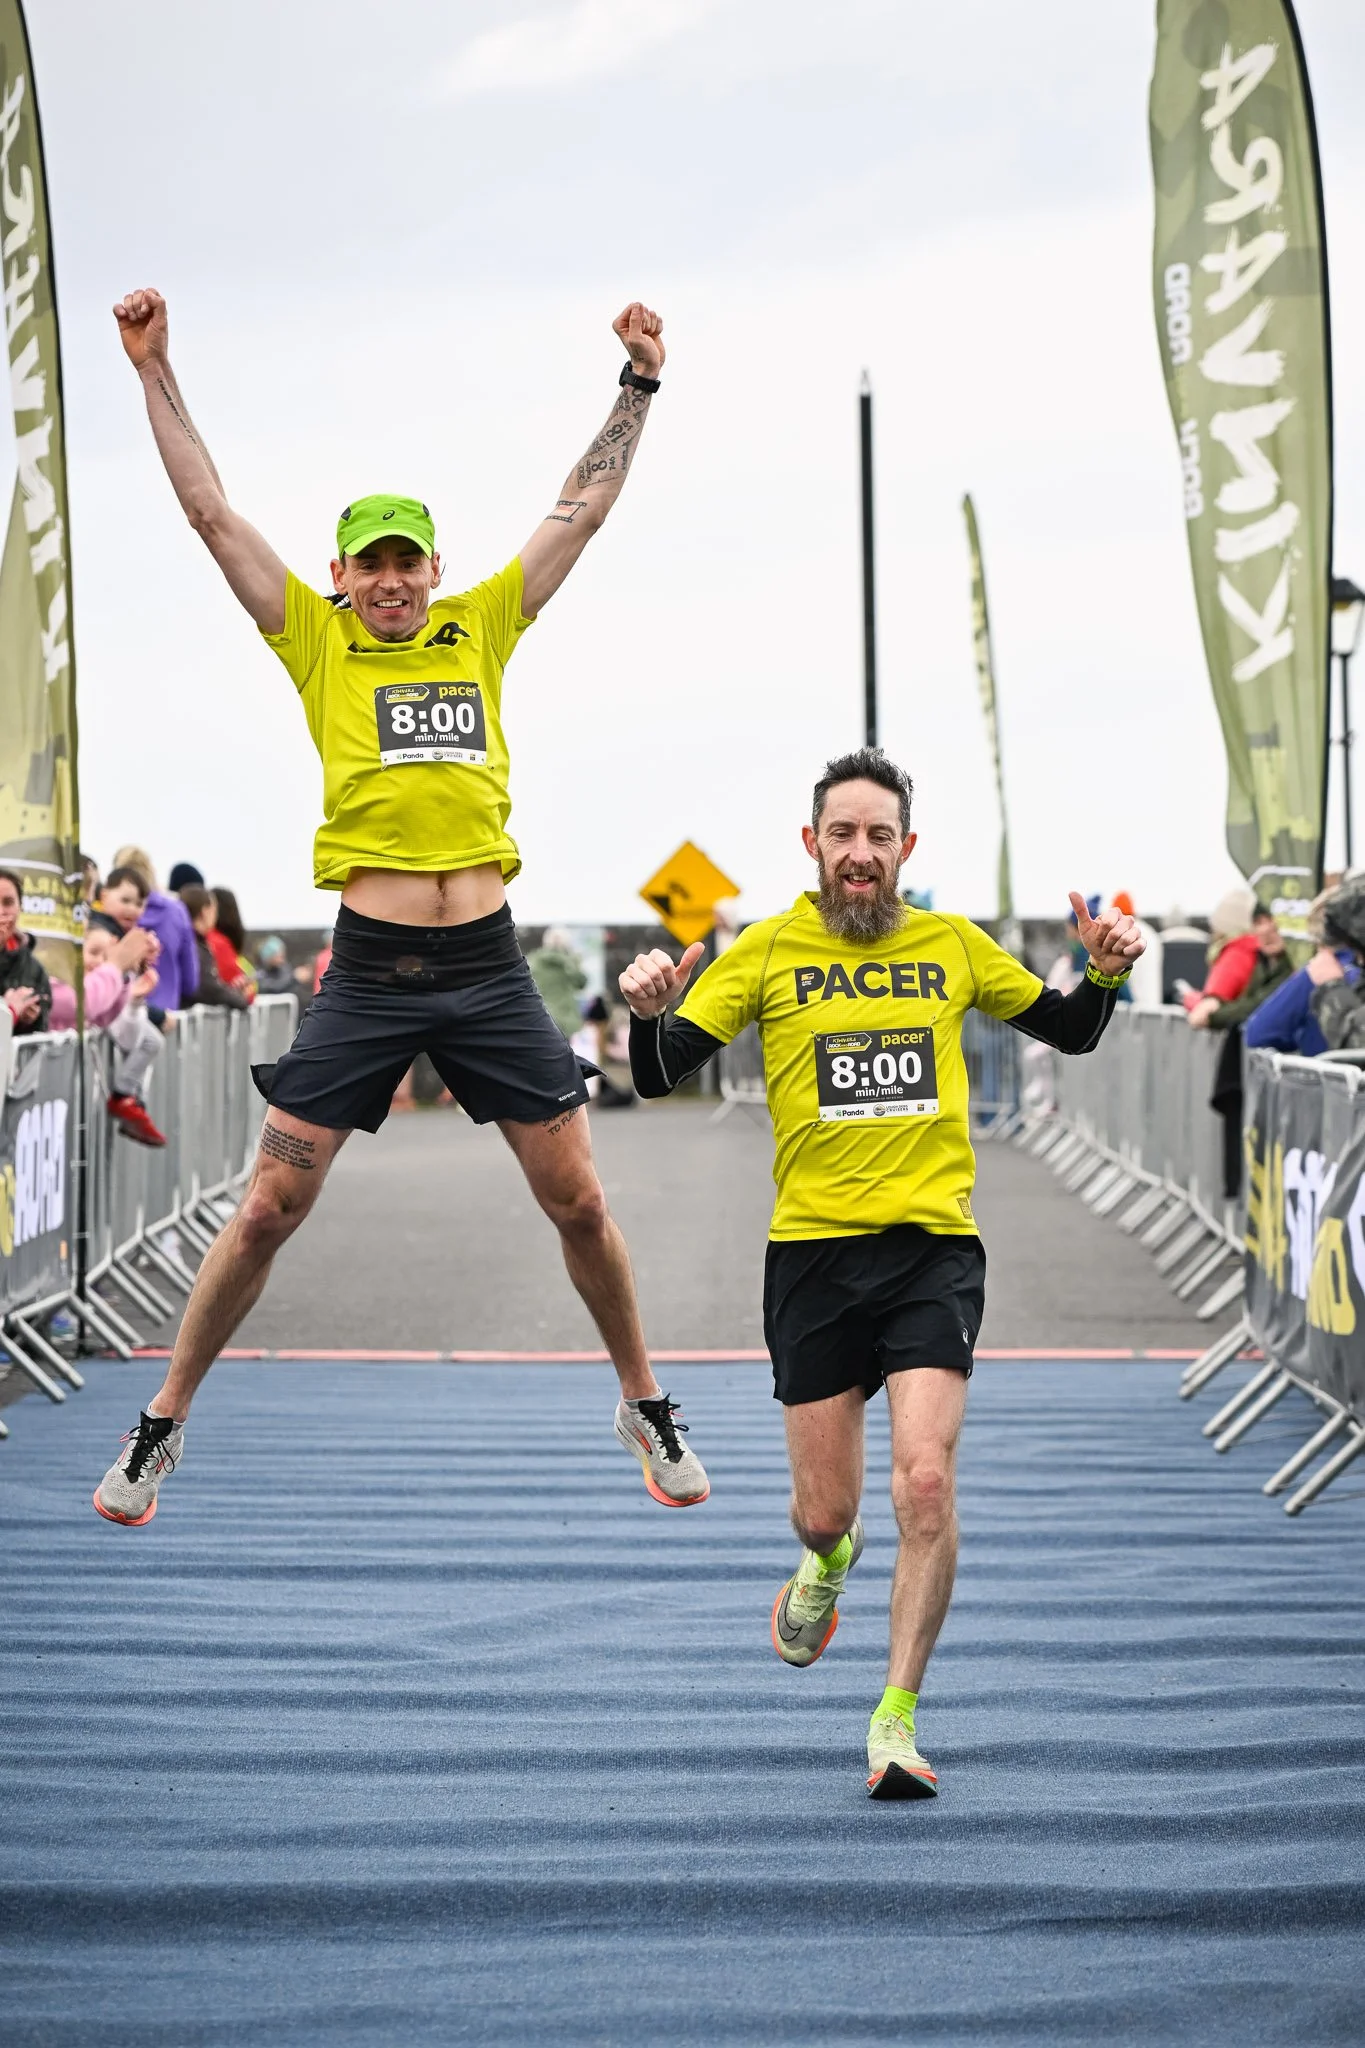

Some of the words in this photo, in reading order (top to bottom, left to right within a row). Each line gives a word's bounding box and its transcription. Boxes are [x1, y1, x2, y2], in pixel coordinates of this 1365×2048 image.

[606, 424, 626, 443] 18
[592, 460, 607, 472] 8
[438, 685, 477, 699] pacer
[390, 702, 476, 735] 8:00
[414, 733, 460, 743] min/mile
[794, 961, 950, 1005] PACER
[880, 1031, 925, 1048] pacer
[831, 1051, 923, 1089] 8:00
[855, 1084, 904, 1098] min/mile
[842, 1109, 865, 1117] Panda
[13, 1098, 69, 1247] ROAD
